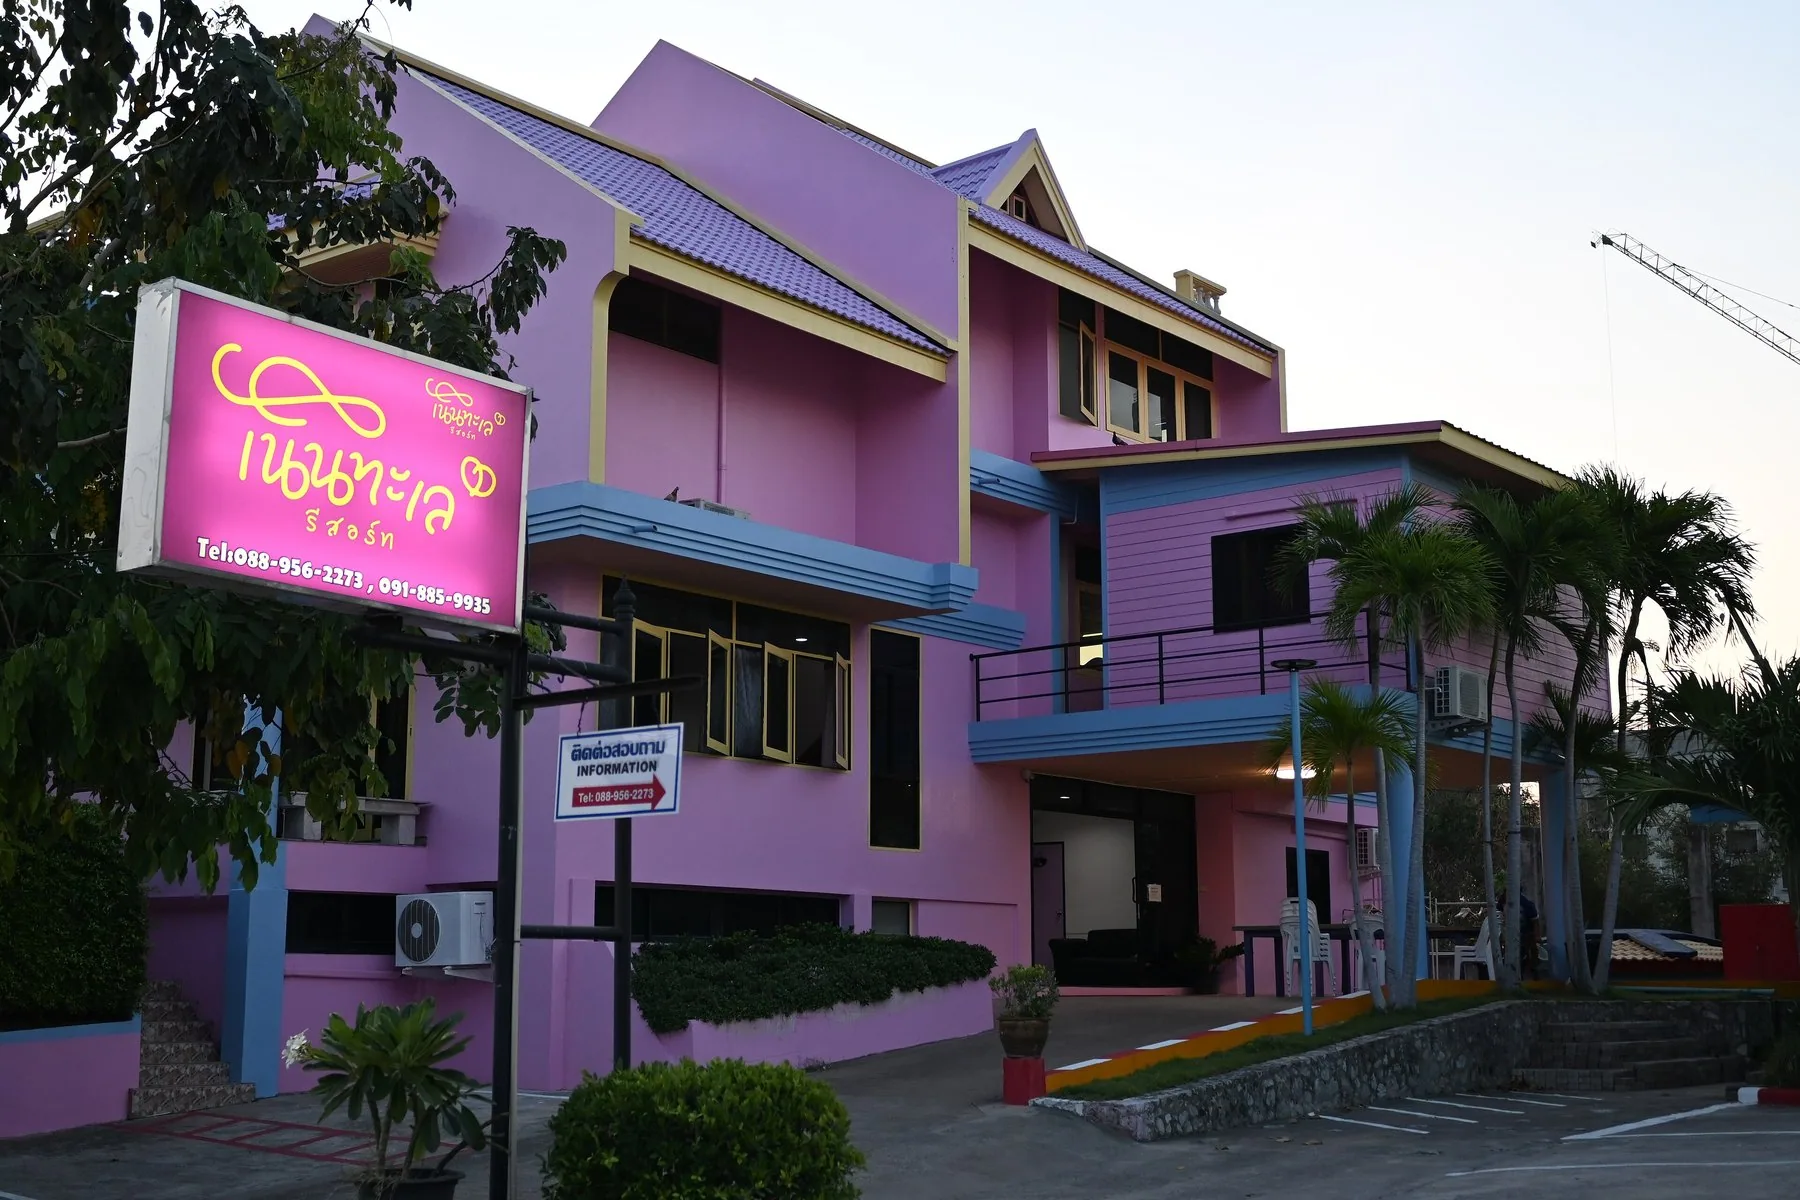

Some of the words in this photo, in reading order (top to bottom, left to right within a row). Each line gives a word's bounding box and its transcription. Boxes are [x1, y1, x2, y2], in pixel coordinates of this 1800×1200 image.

[305, 507, 394, 550] รีสอร์ท
[197, 536, 364, 590] Tel:088-956-2273
[378, 576, 491, 615] 091-885-9935
[570, 740, 666, 762] ติดต่อสอบถาม
[576, 760, 658, 777] INFORMATION
[578, 792, 595, 804] Tel:
[595, 788, 654, 803] 088-956-2273
